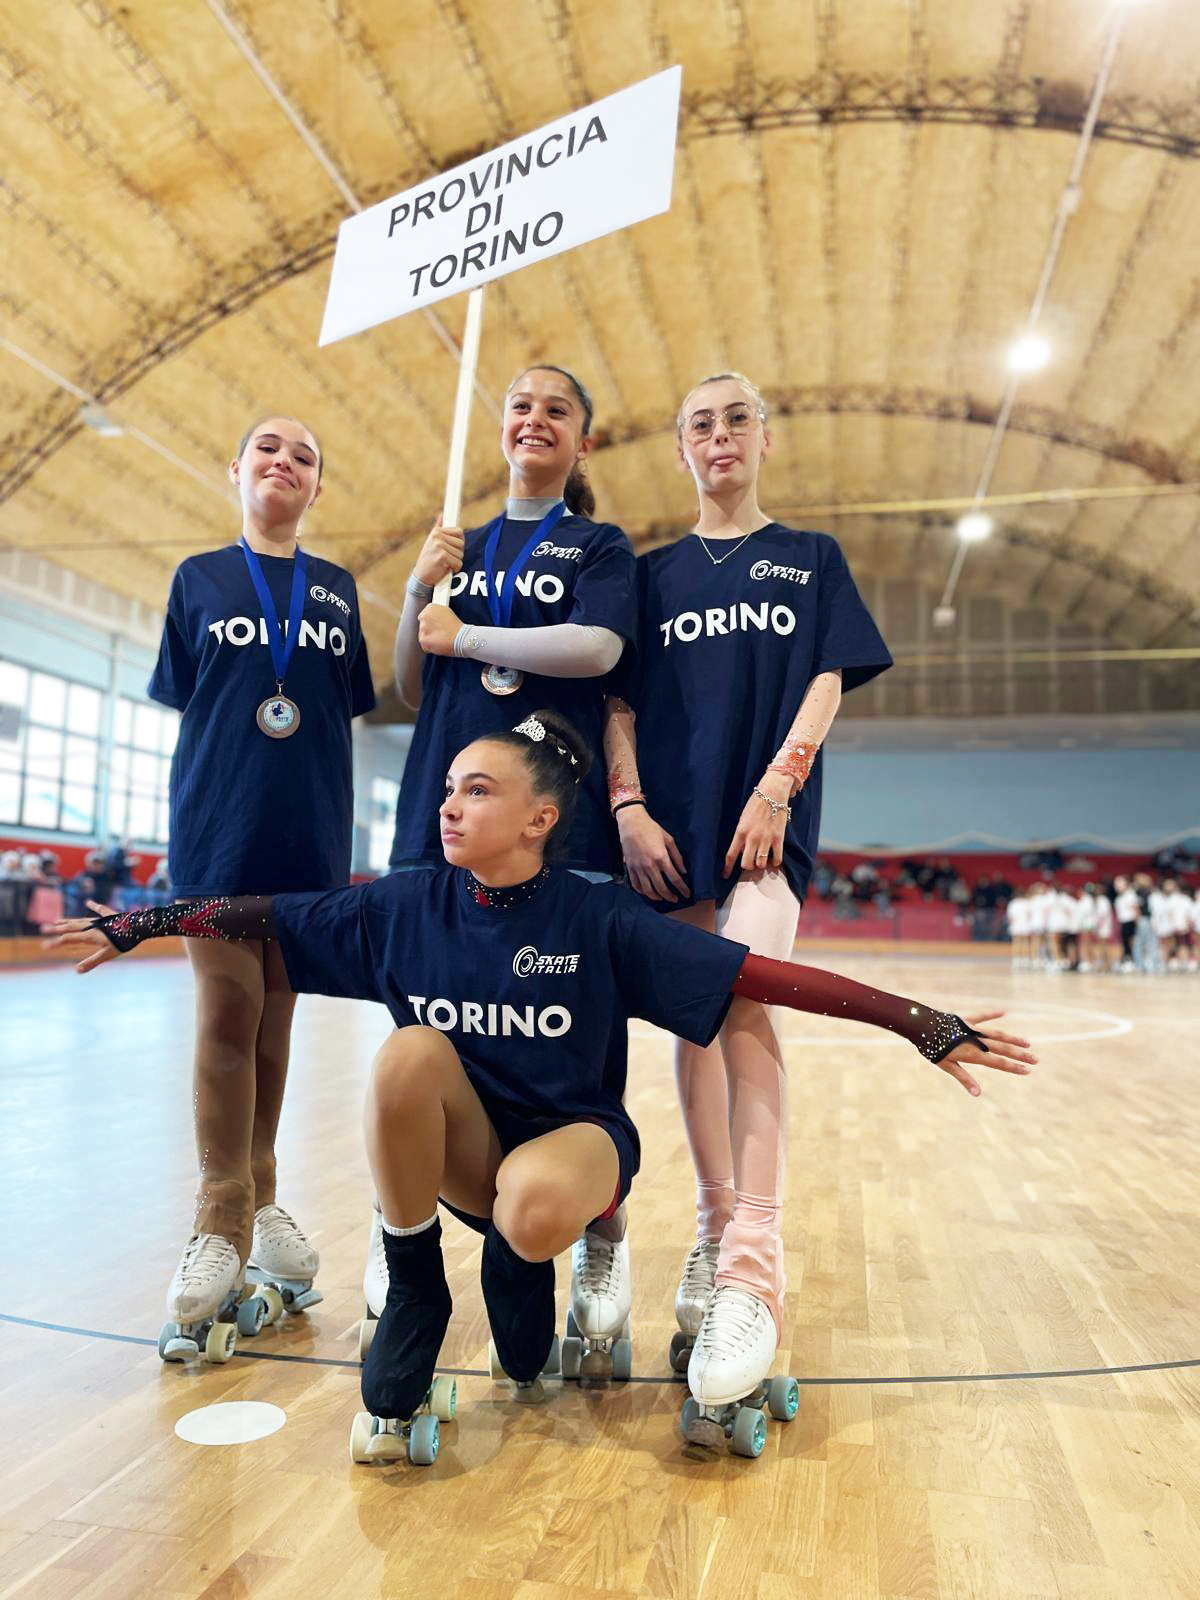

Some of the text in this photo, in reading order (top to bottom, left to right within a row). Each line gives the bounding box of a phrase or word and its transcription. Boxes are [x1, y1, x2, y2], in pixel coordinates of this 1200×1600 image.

[387, 115, 608, 238] PROVINCIA
[464, 194, 504, 238] DI
[409, 211, 564, 297] TORINO
[549, 546, 583, 557] SKAT
[449, 570, 564, 604] ORINO
[766, 571, 809, 585] ITALIA
[769, 565, 812, 579] SKATE
[208, 616, 346, 656] TONO
[659, 601, 796, 647] TORINO
[530, 964, 578, 974] ITALIA
[535, 954, 581, 966] SKATE
[407, 995, 572, 1038] TORINO
